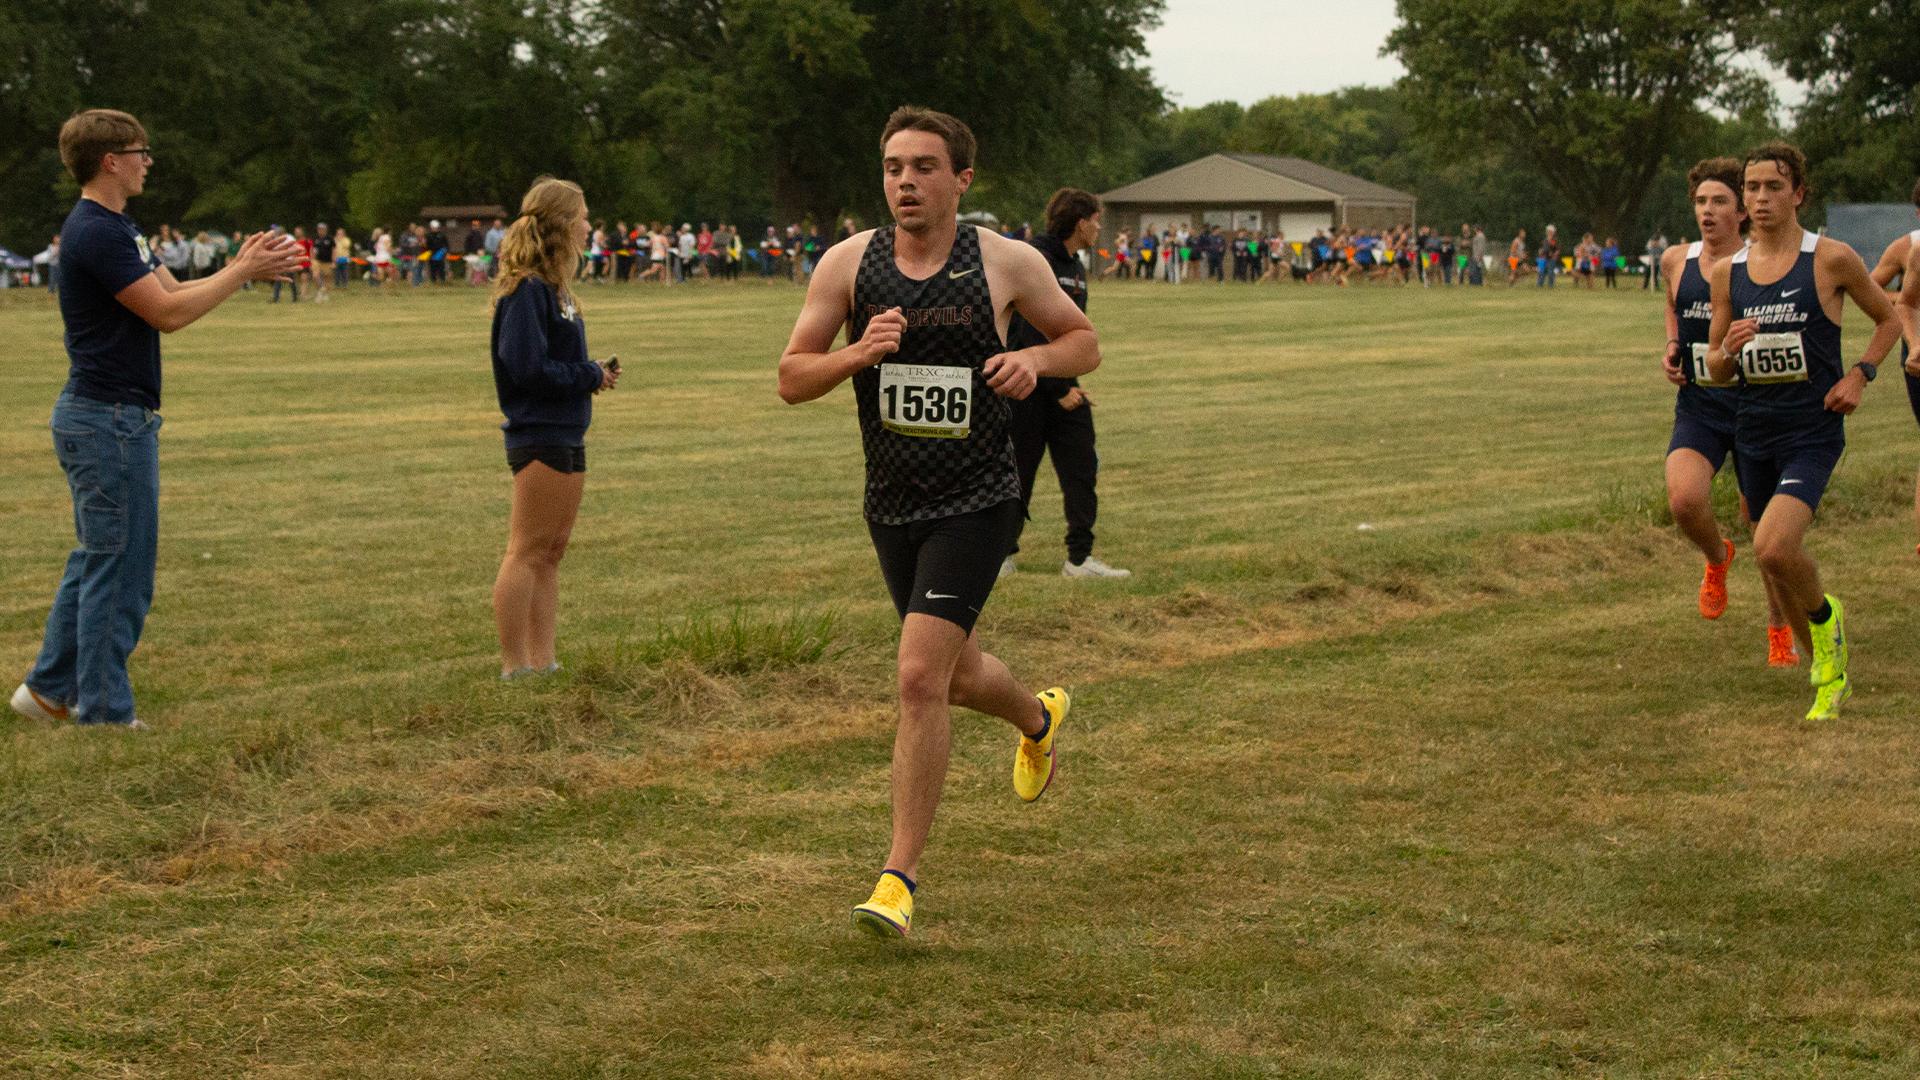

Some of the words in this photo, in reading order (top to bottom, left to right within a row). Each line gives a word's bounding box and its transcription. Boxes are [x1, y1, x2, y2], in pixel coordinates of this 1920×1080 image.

[906, 305, 973, 327] DEVILS
[1743, 302, 1796, 318] ILLINOIS
[1754, 312, 1808, 325] NGFIELD
[1745, 346, 1803, 374] 1555
[903, 366, 944, 377] TRXC
[883, 384, 967, 424] 1536
